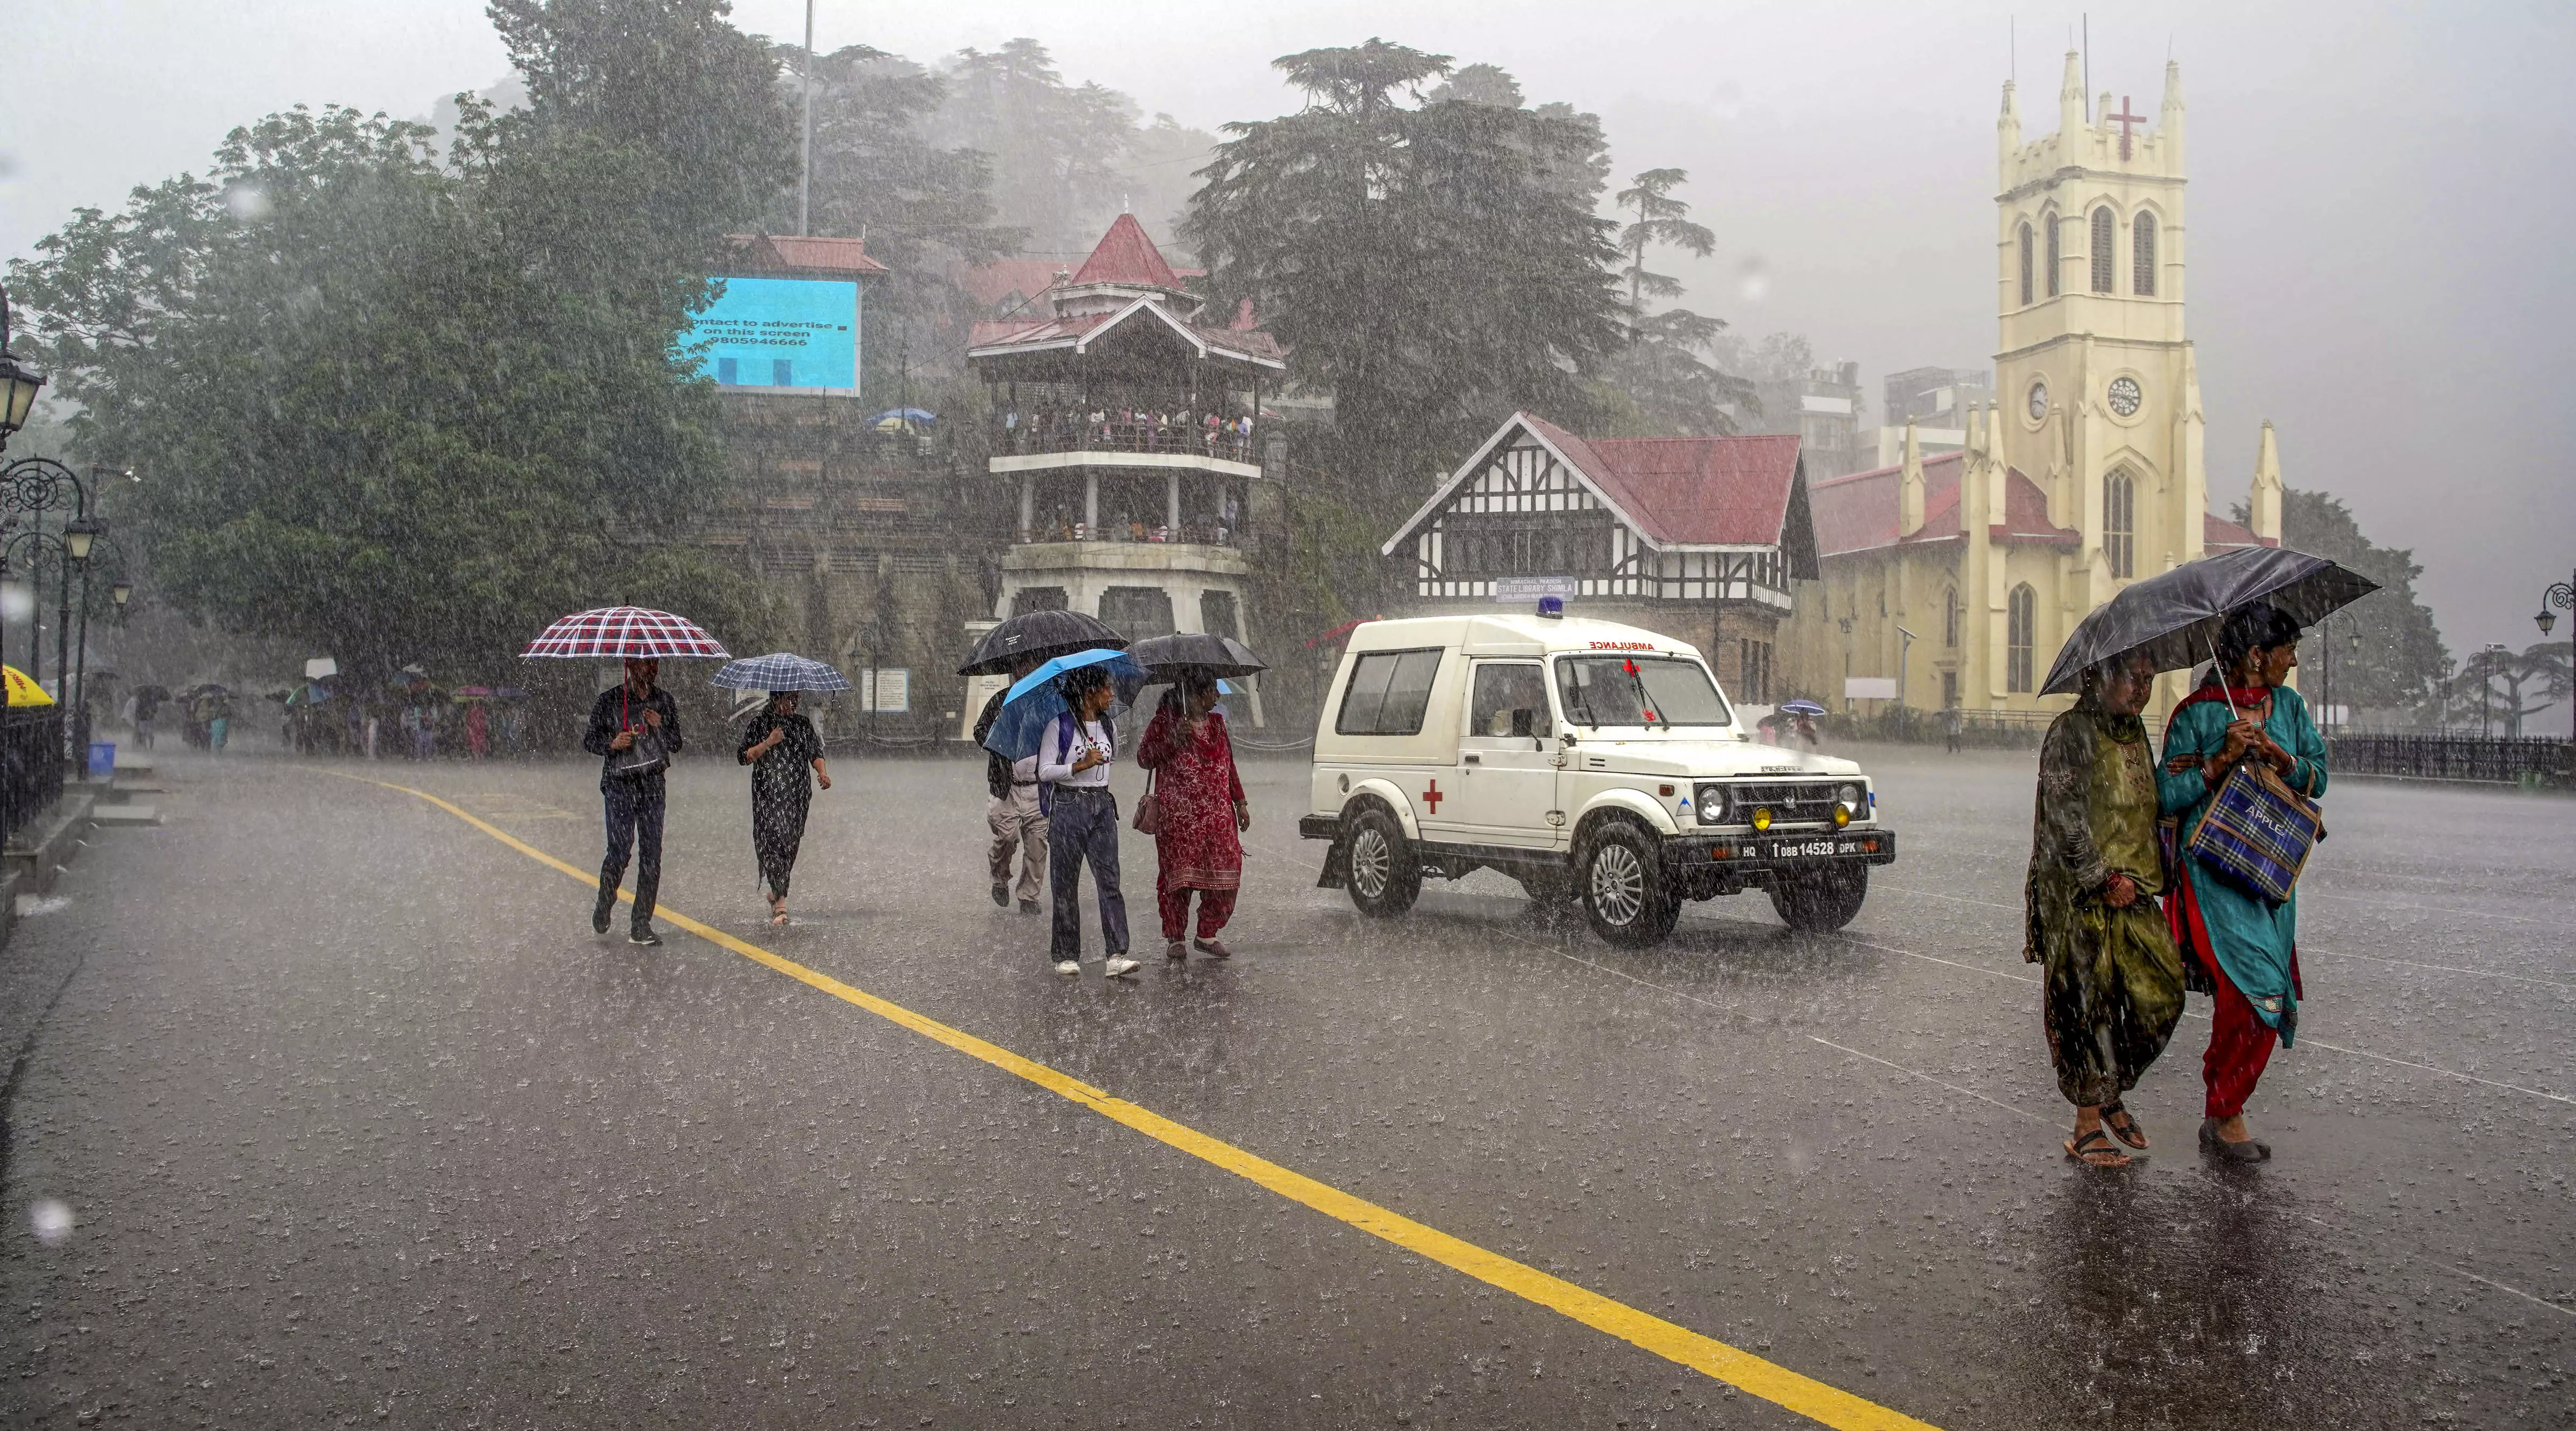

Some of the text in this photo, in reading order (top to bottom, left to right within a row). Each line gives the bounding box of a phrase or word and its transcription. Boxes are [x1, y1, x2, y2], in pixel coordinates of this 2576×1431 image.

[762, 320, 832, 329] advertise
[710, 337, 807, 346] 9805946666
[1519, 585, 1546, 593] LIBRARY
[1547, 584, 1572, 592] SHIMLA
[1743, 842, 1856, 857] HQ 08B 14528 DPK
